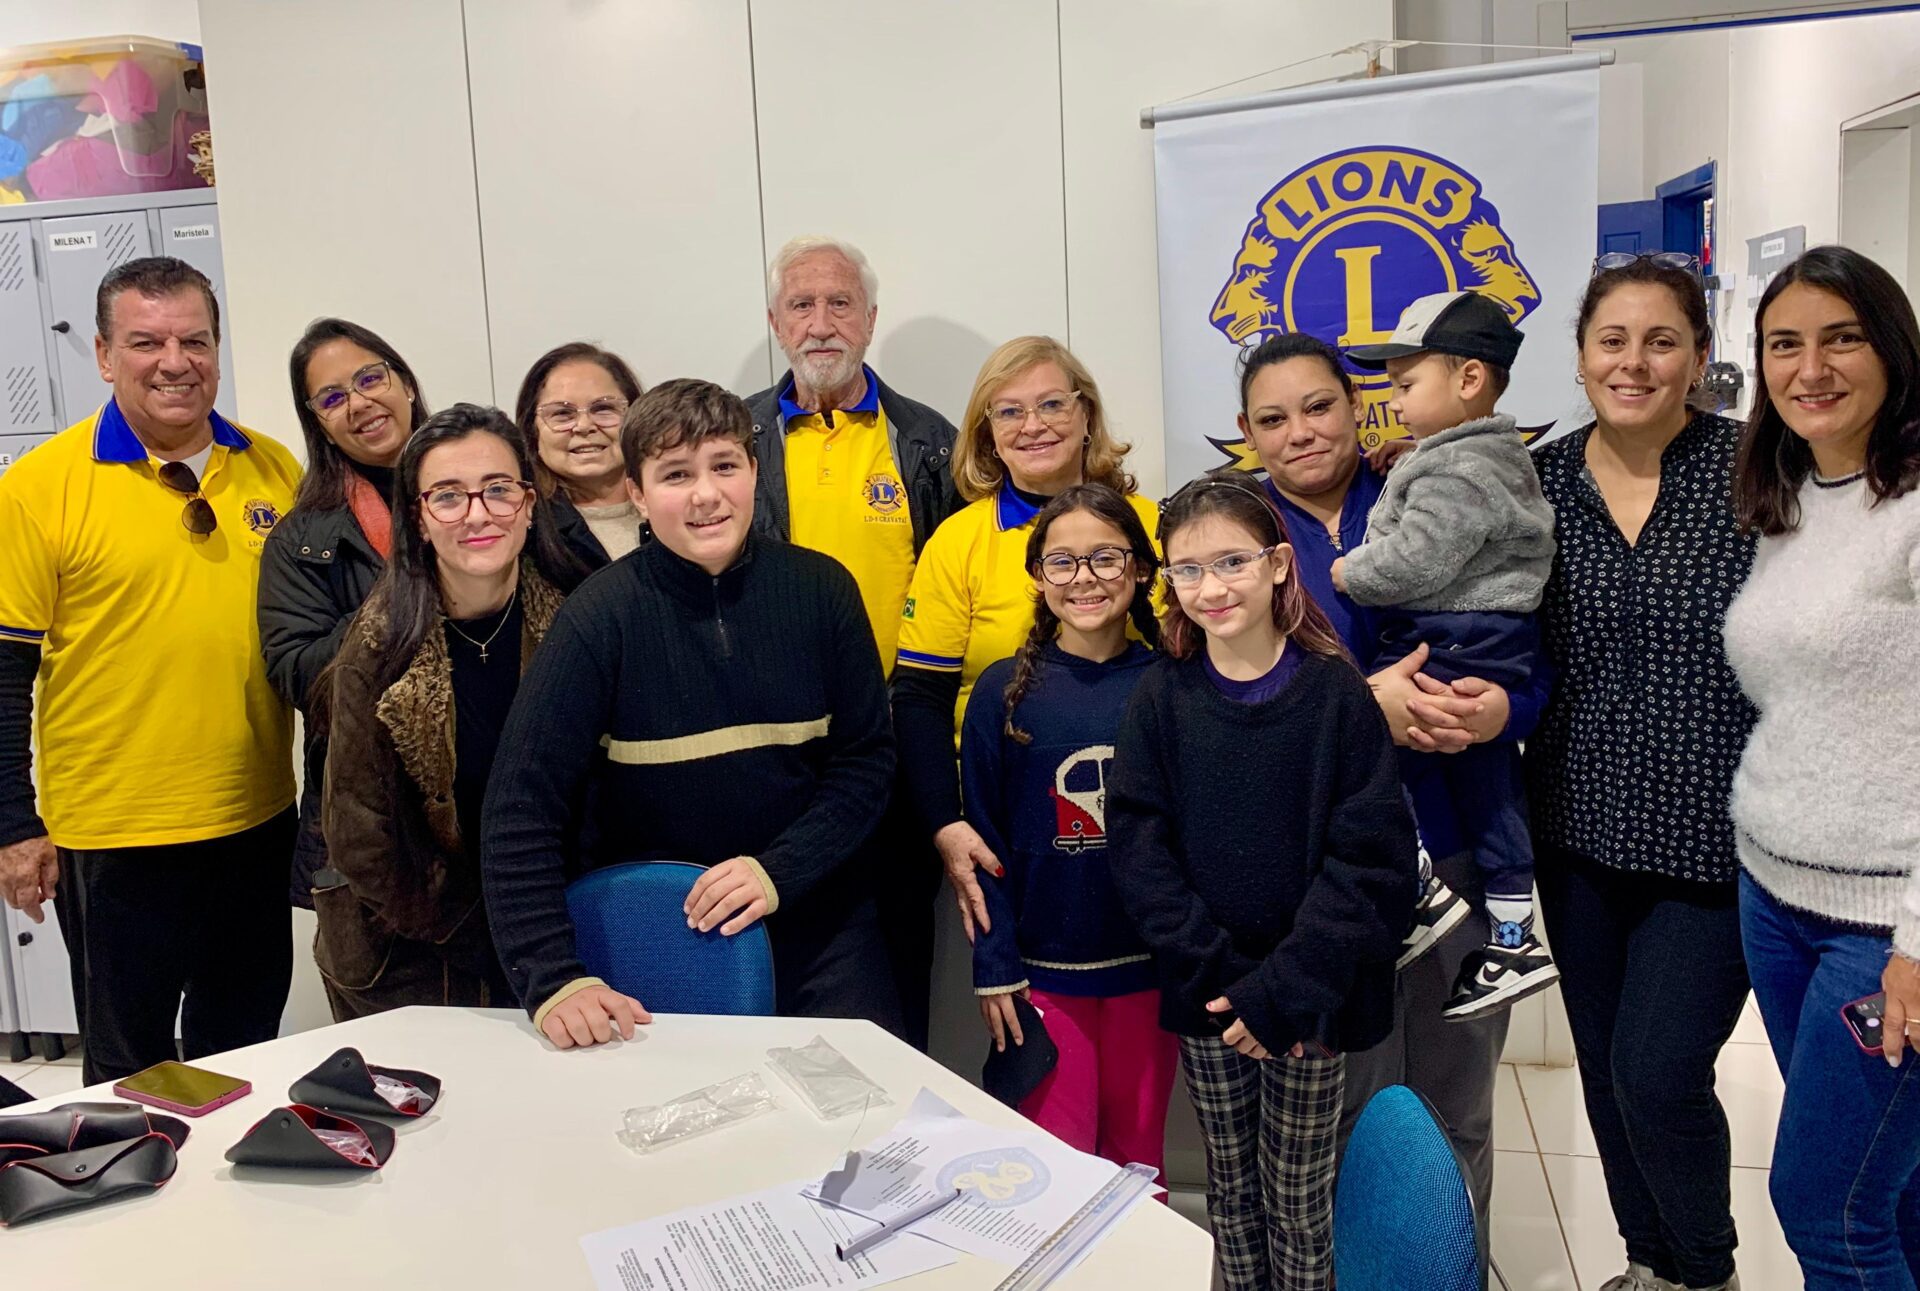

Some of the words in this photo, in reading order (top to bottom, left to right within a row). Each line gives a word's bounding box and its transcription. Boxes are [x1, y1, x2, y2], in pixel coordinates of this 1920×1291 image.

[1274, 159, 1463, 231] LIONS
[54, 237, 85, 246] MILENA
[86, 236, 93, 244] T
[174, 229, 209, 238] Maristela
[1335, 246, 1408, 347] L
[876, 485, 891, 502] L
[255, 510, 272, 526] L
